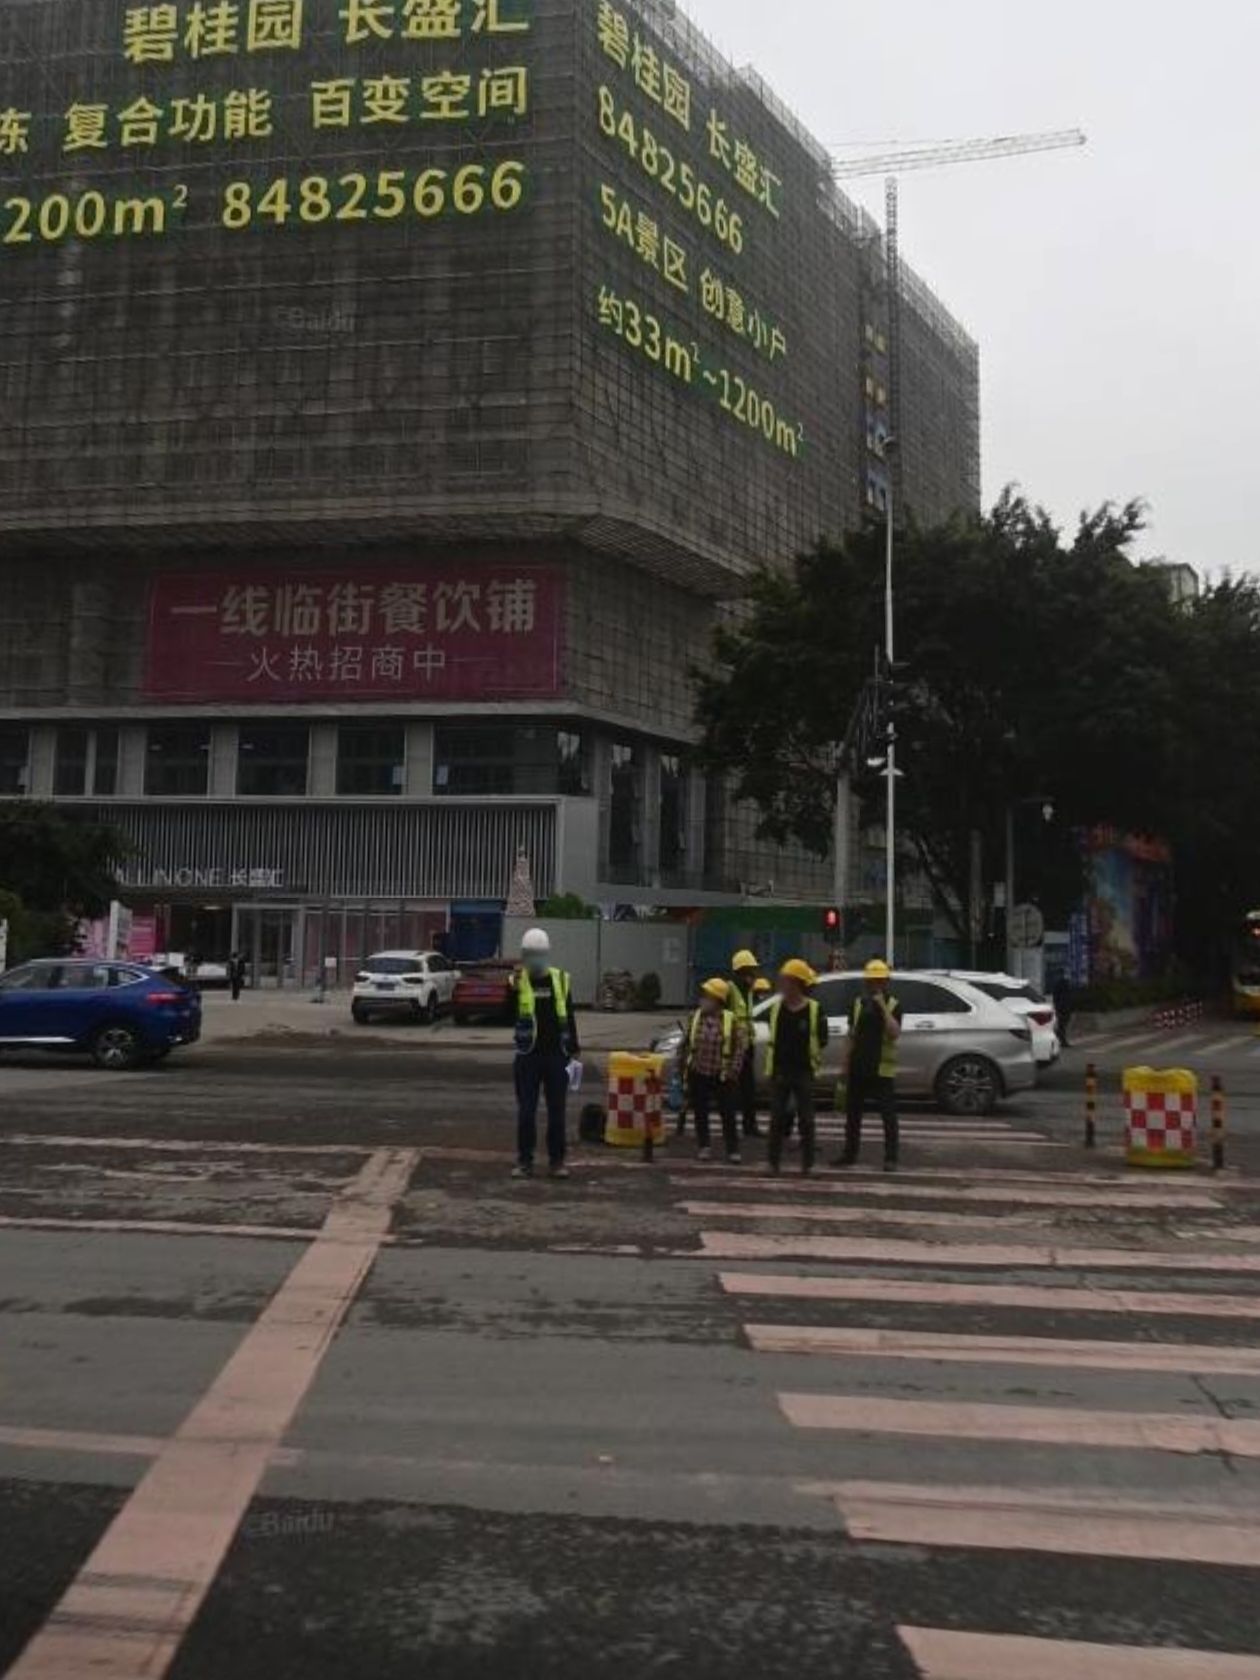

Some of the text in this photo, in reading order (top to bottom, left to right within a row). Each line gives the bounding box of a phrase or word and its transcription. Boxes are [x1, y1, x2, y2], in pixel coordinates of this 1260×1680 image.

[122, 0, 531, 64] 碧桂园 长盛汇
[62, 88, 273, 152] 复合功能
[311, 66, 529, 129] 百变空间
[597, 3, 782, 220] 碧桂园 长盛汇
[221, 160, 524, 230] 84825666
[598, 85, 743, 255] 84825666
[599, 183, 787, 361] 5A景区 创意小户
[171, 578, 536, 638] 一线临街餐饮铺
[246, 643, 446, 682] 火热招商中
